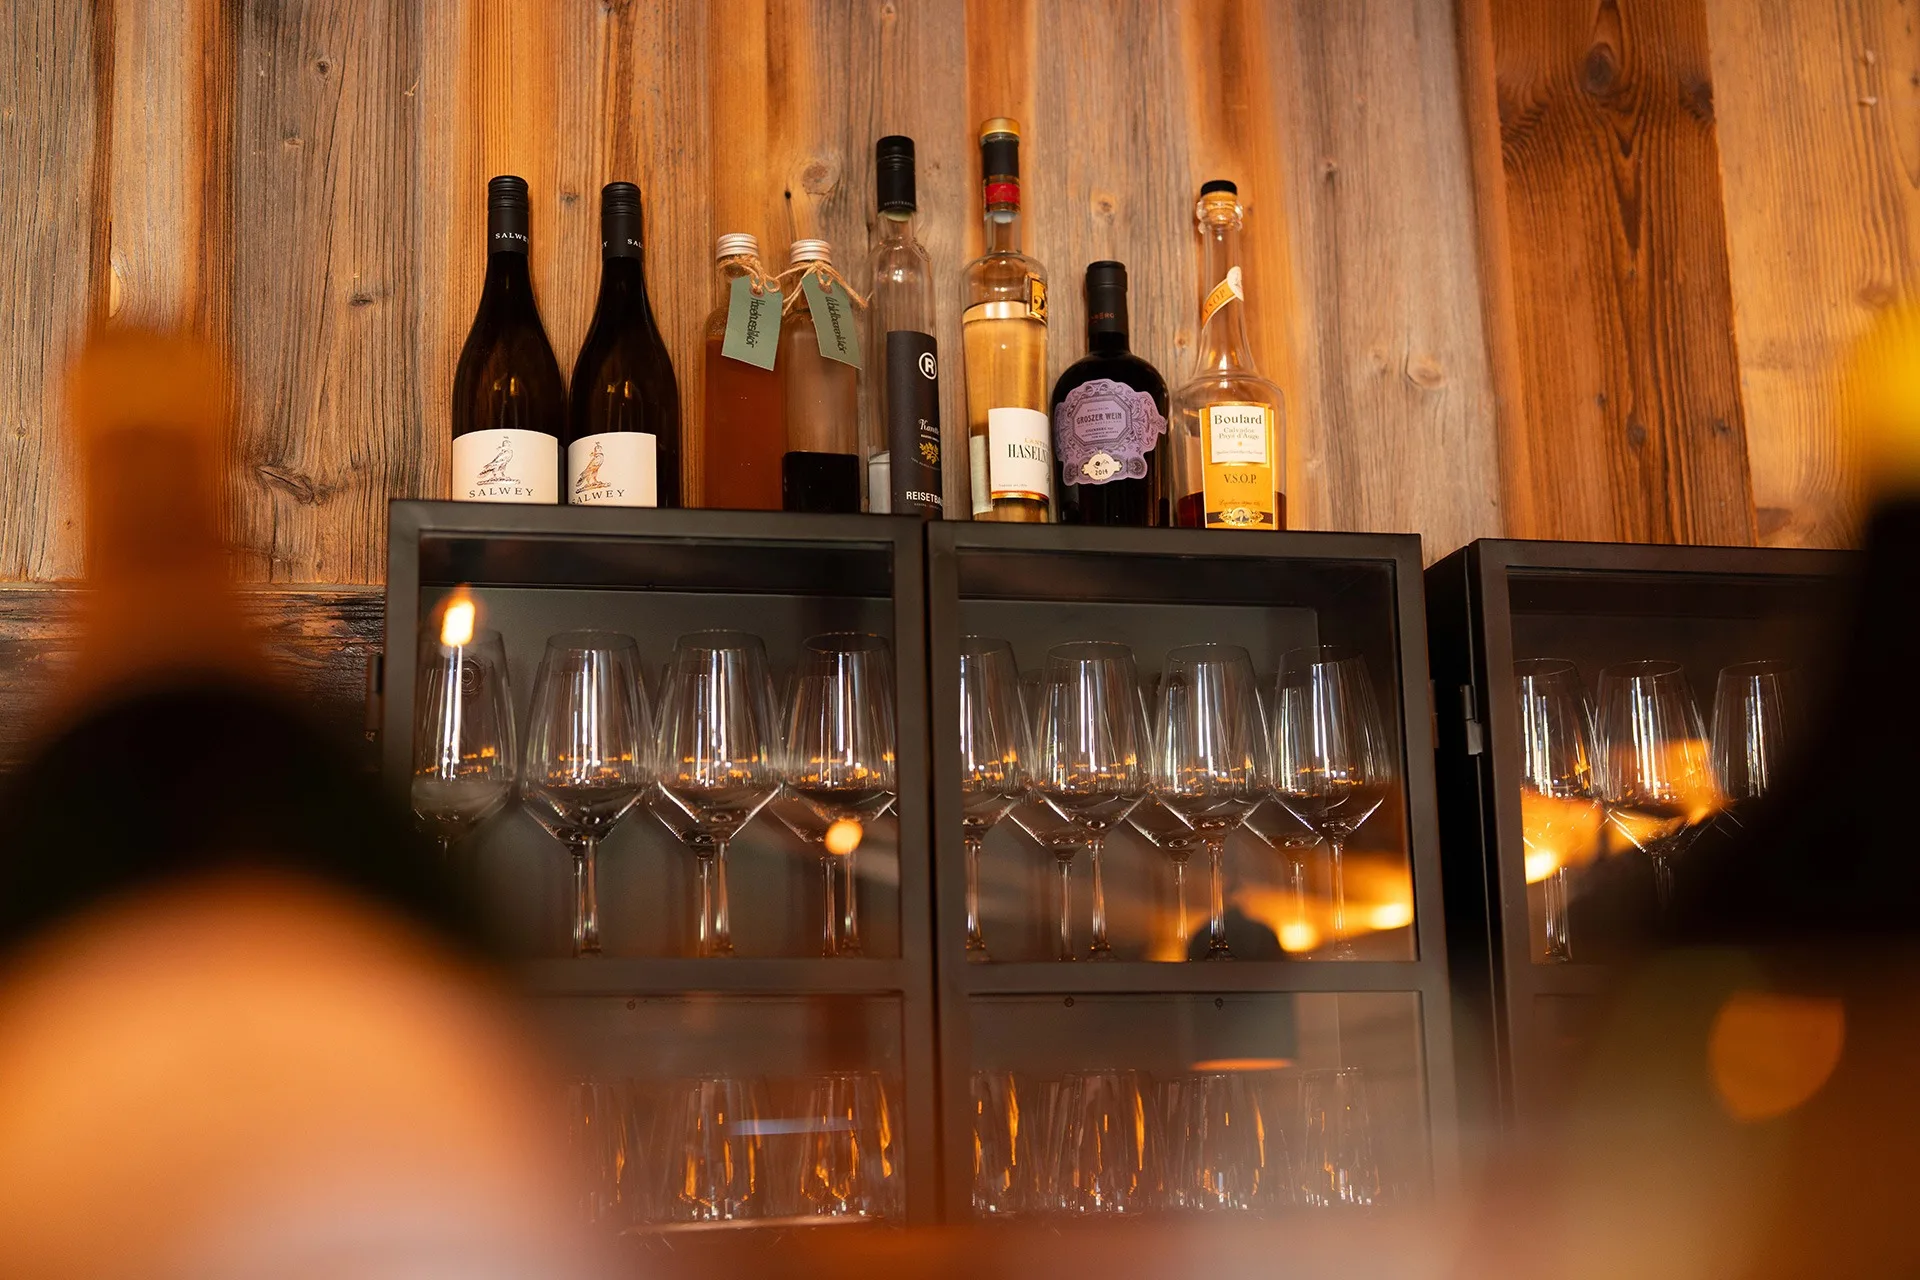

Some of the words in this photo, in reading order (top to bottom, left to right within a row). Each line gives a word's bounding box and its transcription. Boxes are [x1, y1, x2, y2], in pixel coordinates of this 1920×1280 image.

[1077, 413, 1104, 425] GROSZER
[1105, 412, 1122, 420] WEIN
[1214, 414, 1262, 425] Boulard
[469, 487, 534, 498] SALWEY
